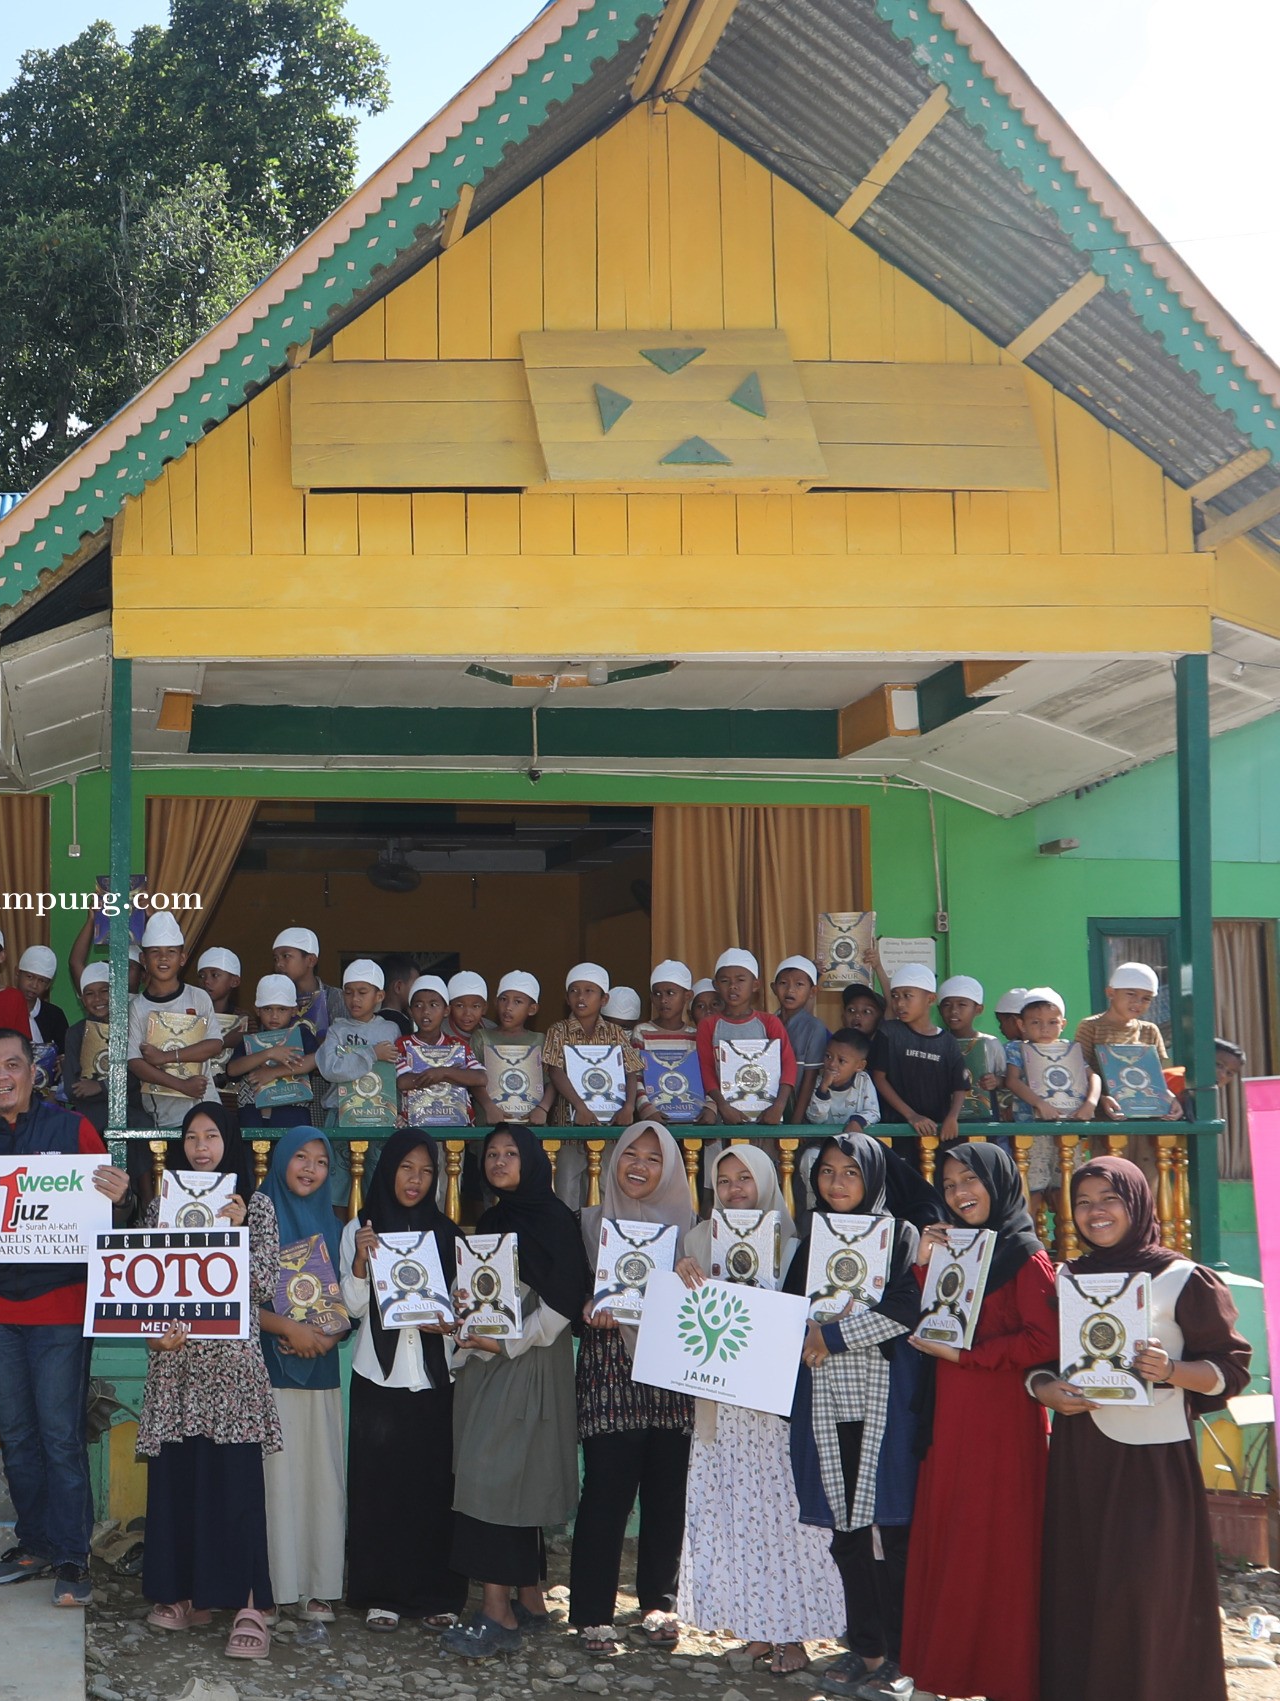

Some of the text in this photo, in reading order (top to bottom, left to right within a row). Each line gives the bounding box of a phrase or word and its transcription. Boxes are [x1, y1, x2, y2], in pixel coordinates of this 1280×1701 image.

[906, 1049, 941, 1061] LIFE TO RIDE
[19, 1169, 85, 1192] week
[10, 1199, 49, 1226] juz
[25, 1222, 47, 1231] Surah
[48, 1222, 78, 1231] Al-Kahfi
[34, 1234, 79, 1243] TAKLIM
[104, 1233, 230, 1248] PEWARTA
[33, 1246, 51, 1255] AL
[53, 1246, 88, 1255] KAHF
[100, 1252, 238, 1298] FOTO
[102, 1303, 231, 1317] INDONESIA
[396, 1302, 438, 1312] AN-NUR
[310, 1312, 335, 1326] NUR
[471, 1315, 505, 1324] AN-NUR
[926, 1318, 957, 1329] AN-NUR
[140, 1321, 192, 1333] MEDN
[683, 1369, 727, 1388] JAMPI
[1080, 1375, 1130, 1386] AN-NUR
